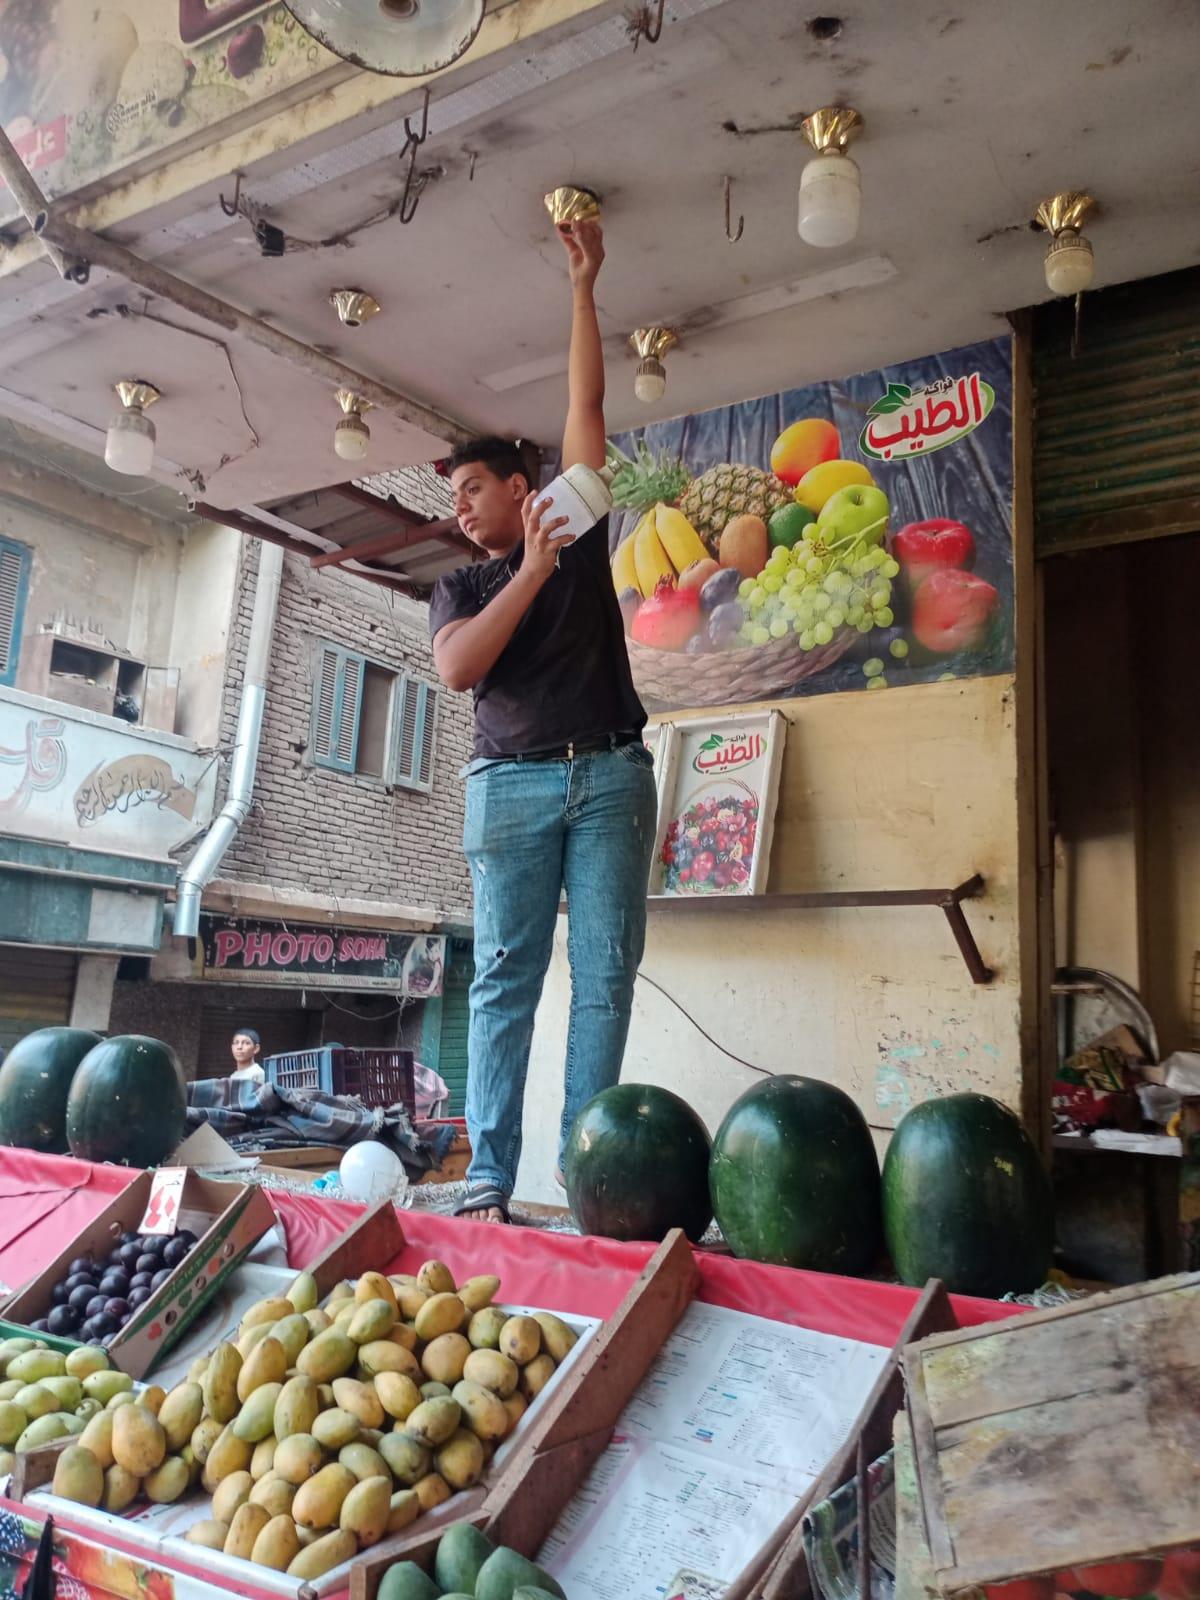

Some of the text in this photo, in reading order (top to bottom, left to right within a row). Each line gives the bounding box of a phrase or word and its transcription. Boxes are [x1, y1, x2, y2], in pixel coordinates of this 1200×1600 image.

[868, 374, 982, 459] الطيب
[697, 734, 760, 774] الطيب
[213, 930, 389, 968] PHOTO SOHA
